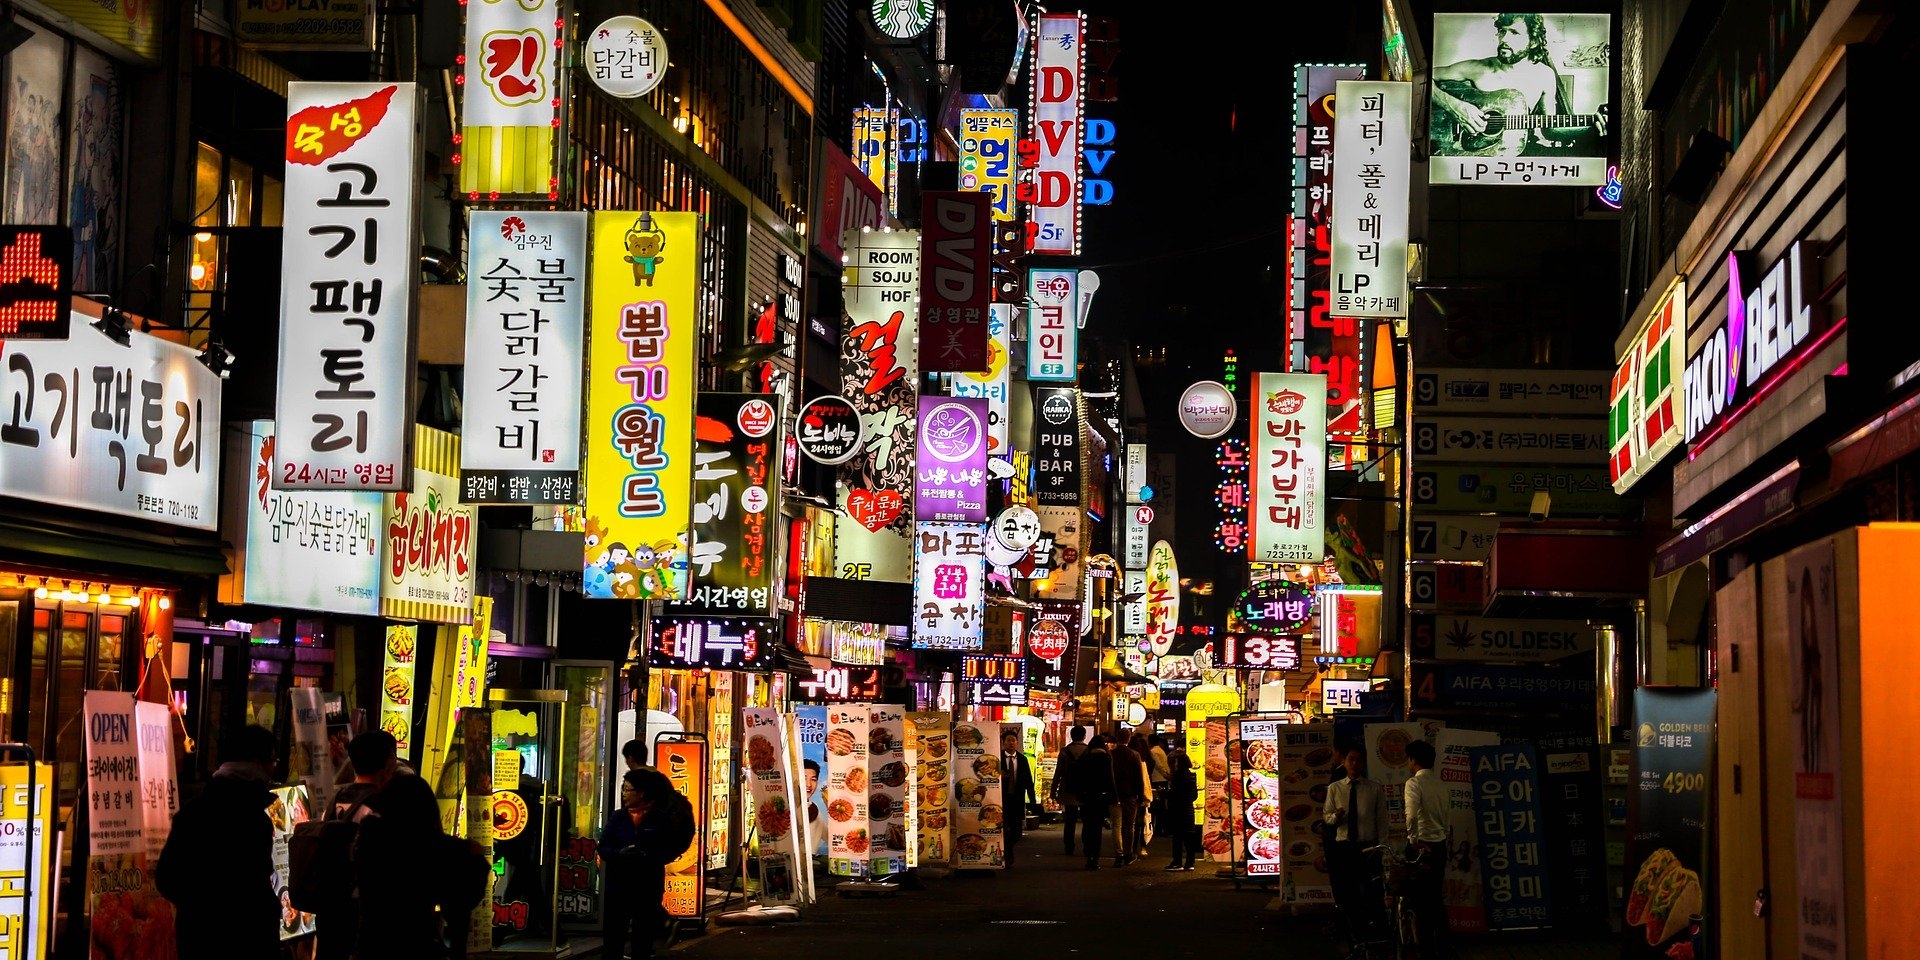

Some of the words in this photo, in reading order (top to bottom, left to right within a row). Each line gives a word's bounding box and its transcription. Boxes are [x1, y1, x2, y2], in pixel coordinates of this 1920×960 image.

[625, 29, 655, 46] 숯불
[593, 48, 658, 80] 닭갈비
[293, 107, 362, 156] 숙성
[1038, 66, 1075, 208] DVD
[1083, 119, 1116, 205] DVD
[1309, 126, 1332, 207] 프라하
[1460, 163, 1489, 181] LP
[1494, 161, 1580, 183] 구멍가게
[513, 234, 552, 251] 김우진
[1041, 223, 1064, 241] 5F
[868, 251, 913, 264] ROOM
[934, 197, 976, 302] DVD
[480, 257, 576, 303] 숯불
[785, 255, 803, 289] ROOM
[872, 271, 912, 284] SOJU
[1337, 273, 1370, 294] LP
[881, 291, 911, 303] HOF
[1336, 296, 1400, 312] 음악카페
[784, 293, 800, 324] SOJU
[927, 306, 980, 323] 상영관
[1040, 305, 1065, 360] 코인
[1682, 327, 1727, 444] TACO
[1746, 240, 1811, 388] BELL
[1043, 364, 1061, 374] 3F
[495, 308, 550, 461] 닭갈비
[1417, 377, 1435, 402] 9
[1546, 382, 1604, 401] 스페인어
[615, 302, 667, 514] 뽑기월드
[1184, 404, 1230, 416] 박가부대
[1041, 434, 1073, 446] PUB
[1417, 426, 1434, 451] 8
[1053, 449, 1061, 458] &
[284, 462, 347, 485] 24시간
[353, 462, 395, 485] 영업
[1039, 460, 1073, 472] BAR
[1266, 418, 1306, 530] 박가부대
[467, 476, 498, 499] 닭갈비
[540, 477, 572, 500] 삼겹살
[1050, 476, 1065, 486] 3F
[1417, 475, 1434, 500] 8
[850, 495, 875, 519] 주식
[878, 495, 901, 510] 문화
[957, 501, 981, 510] Pizza
[1220, 445, 1245, 547] 노래방
[168, 501, 199, 520] 720-1192
[865, 512, 890, 528] 공간
[269, 494, 371, 556] 김우진숯불닭갈비
[1002, 518, 1038, 541] 곱창
[921, 531, 982, 557] 마포
[1416, 526, 1432, 549] 7
[1266, 550, 1313, 560] 723-2112
[842, 563, 872, 580] 2F
[936, 582, 964, 596] 구이
[1415, 575, 1433, 600] 6
[921, 603, 979, 630] 곱창
[1037, 611, 1071, 623] Luxury
[1146, 580, 1175, 646] 노래방
[1246, 600, 1306, 621] 노래방
[934, 635, 978, 646] 732-1197
[1030, 637, 1067, 650] 羊肉串
[1415, 624, 1432, 648] 5
[1481, 630, 1578, 651] SOLDESK
[966, 658, 1015, 679] DVD
[1417, 670, 1437, 702] 4
[1452, 676, 1493, 690] AIFA
[91, 712, 130, 743] OPEN
[140, 722, 168, 753] OPEN
[1659, 722, 1692, 733] GOLDEN
[1659, 734, 1692, 748] 더블타코
[1477, 752, 1532, 774] AIFA
[1441, 769, 1473, 782] STRIKE
[1662, 770, 1705, 794] 4900
[1480, 779, 1513, 903] 우리경영
[1508, 778, 1544, 900] 아카데미
